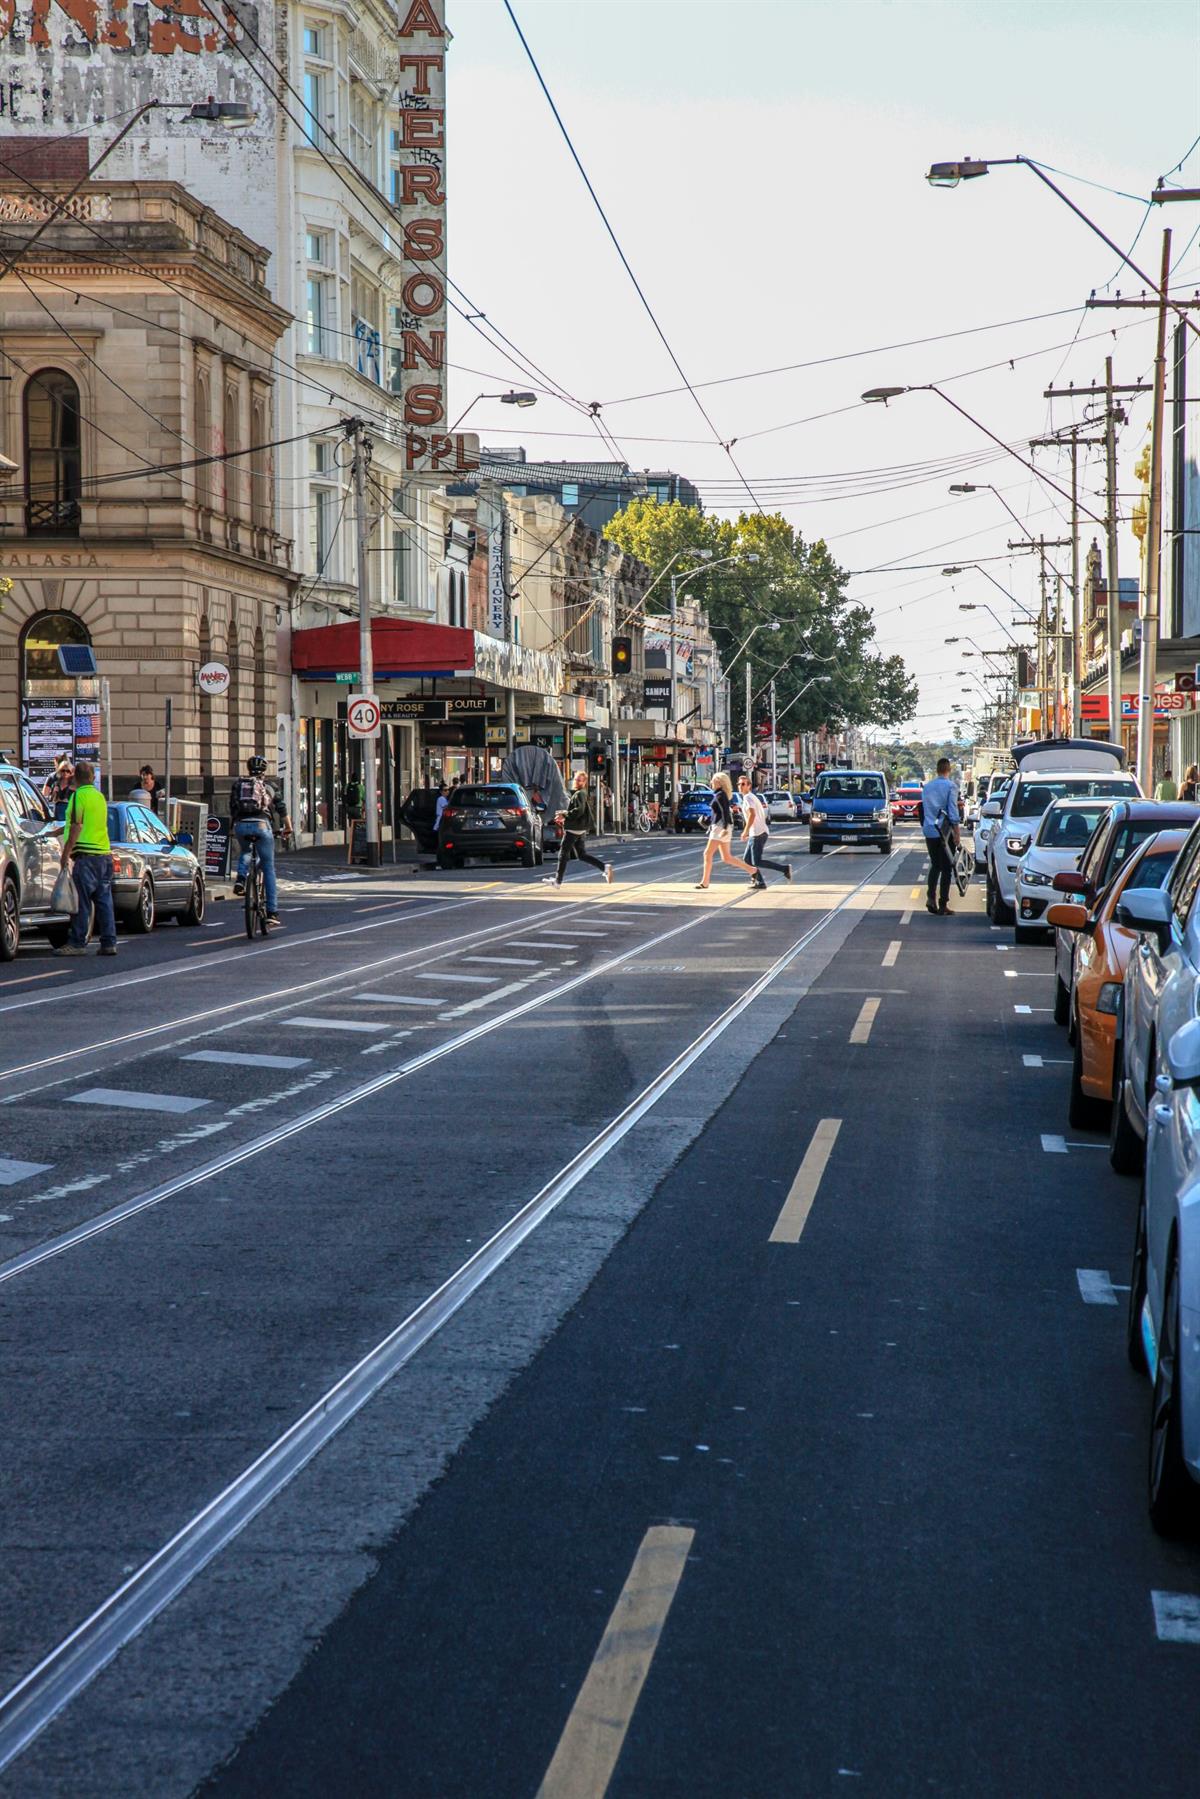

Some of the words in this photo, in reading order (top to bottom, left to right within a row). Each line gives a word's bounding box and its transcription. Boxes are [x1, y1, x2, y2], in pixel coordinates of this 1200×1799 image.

[406, 433, 480, 470] PPL
[492, 545, 504, 629] STATIONERY
[336, 672, 353, 681] WEBB
[645, 687, 670, 696] SAMPLE
[455, 699, 488, 709] OUTLET
[1133, 694, 1182, 708] cles
[396, 703, 425, 712] ROSE
[353, 708, 375, 724] 40
